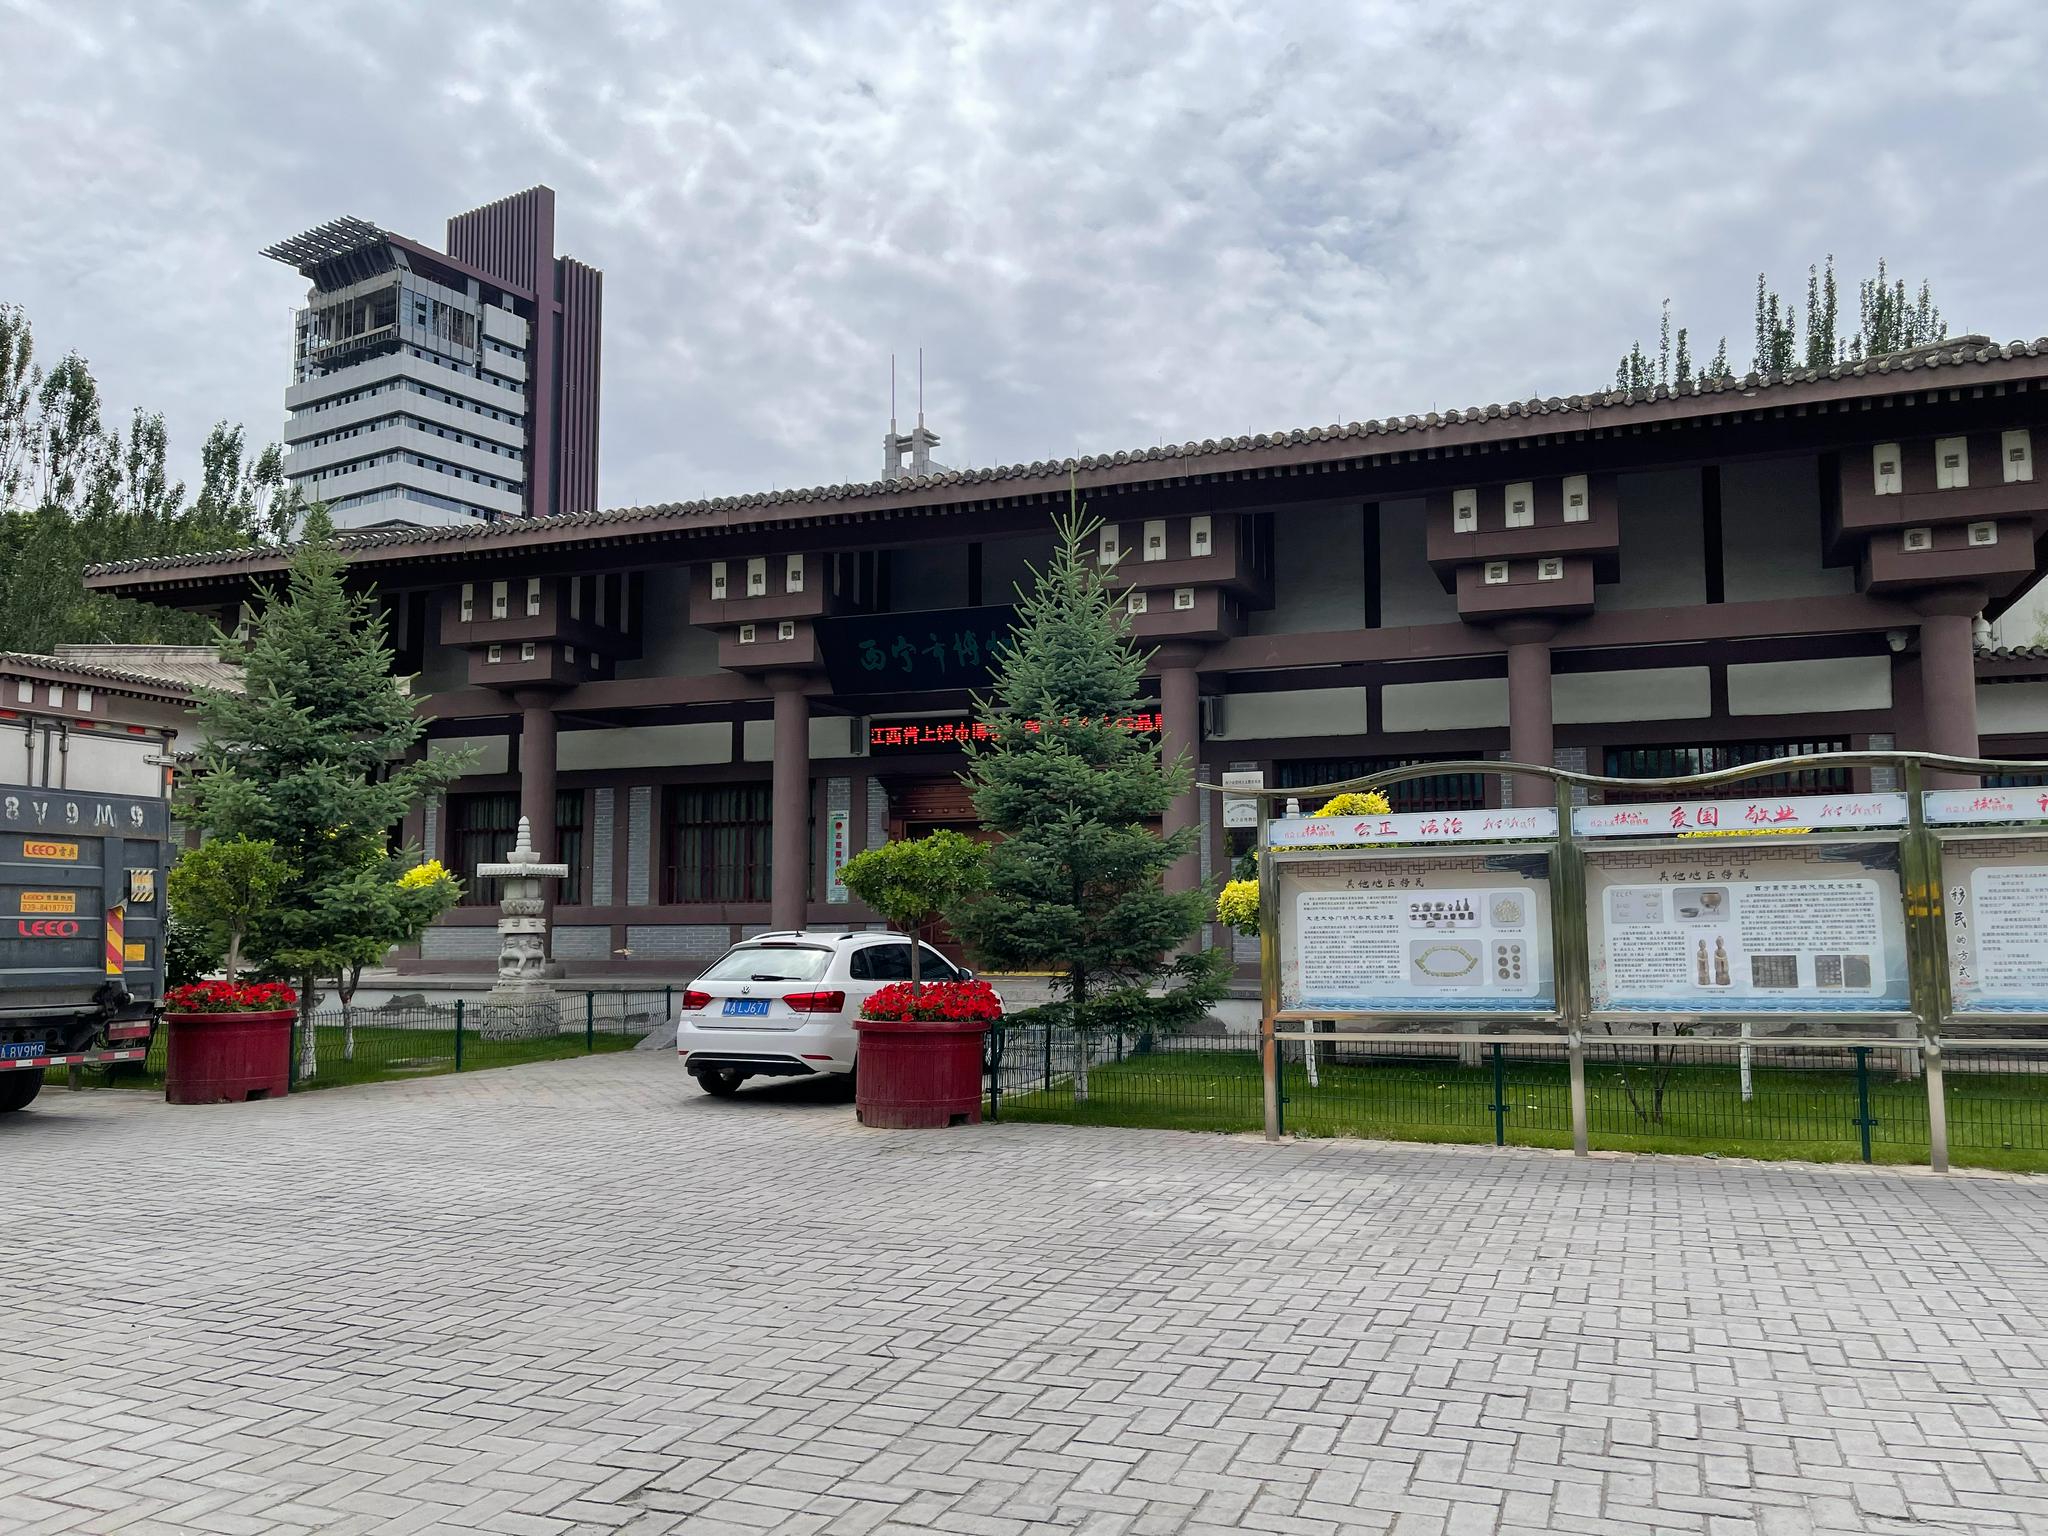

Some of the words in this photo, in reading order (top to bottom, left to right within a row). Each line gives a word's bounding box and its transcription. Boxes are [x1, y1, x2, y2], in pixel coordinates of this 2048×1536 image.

[1669, 806, 1719, 828] 爱国
[1744, 804, 1798, 824] 敬业
[1354, 822, 1398, 836] 公正
[1420, 818, 1462, 834] 法治
[834, 832, 843, 886] 志愿服务站
[1345, 877, 1425, 889] 其他地区移民
[1658, 869, 1749, 882] 其他地区移民
[18, 919, 79, 937] LEEO
[1950, 886, 1971, 978] 移民的方式
